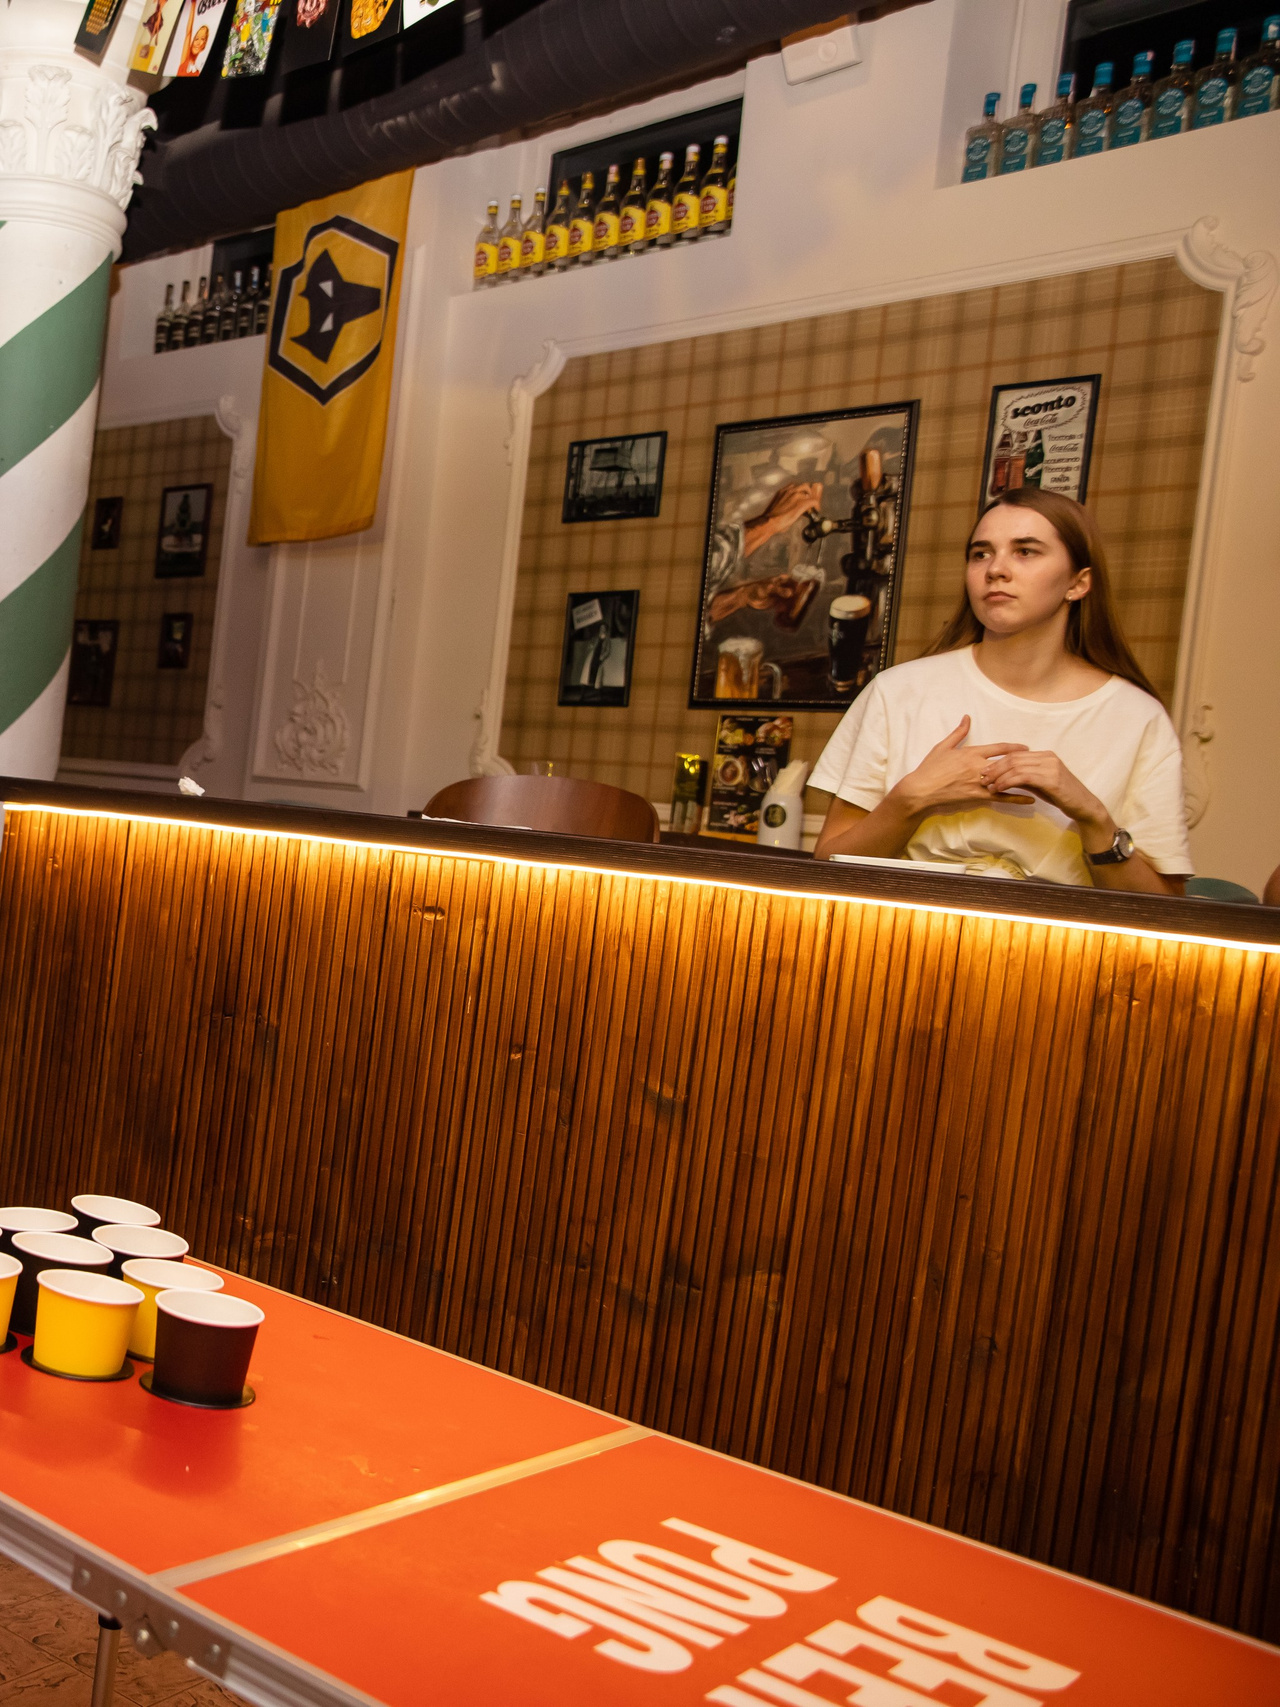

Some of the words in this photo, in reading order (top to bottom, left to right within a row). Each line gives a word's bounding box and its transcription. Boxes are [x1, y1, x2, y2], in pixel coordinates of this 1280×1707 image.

[1010, 395, 1076, 419] sconto
[479, 1517, 839, 1673] PONG
[704, 1595, 1082, 1707] BEE
